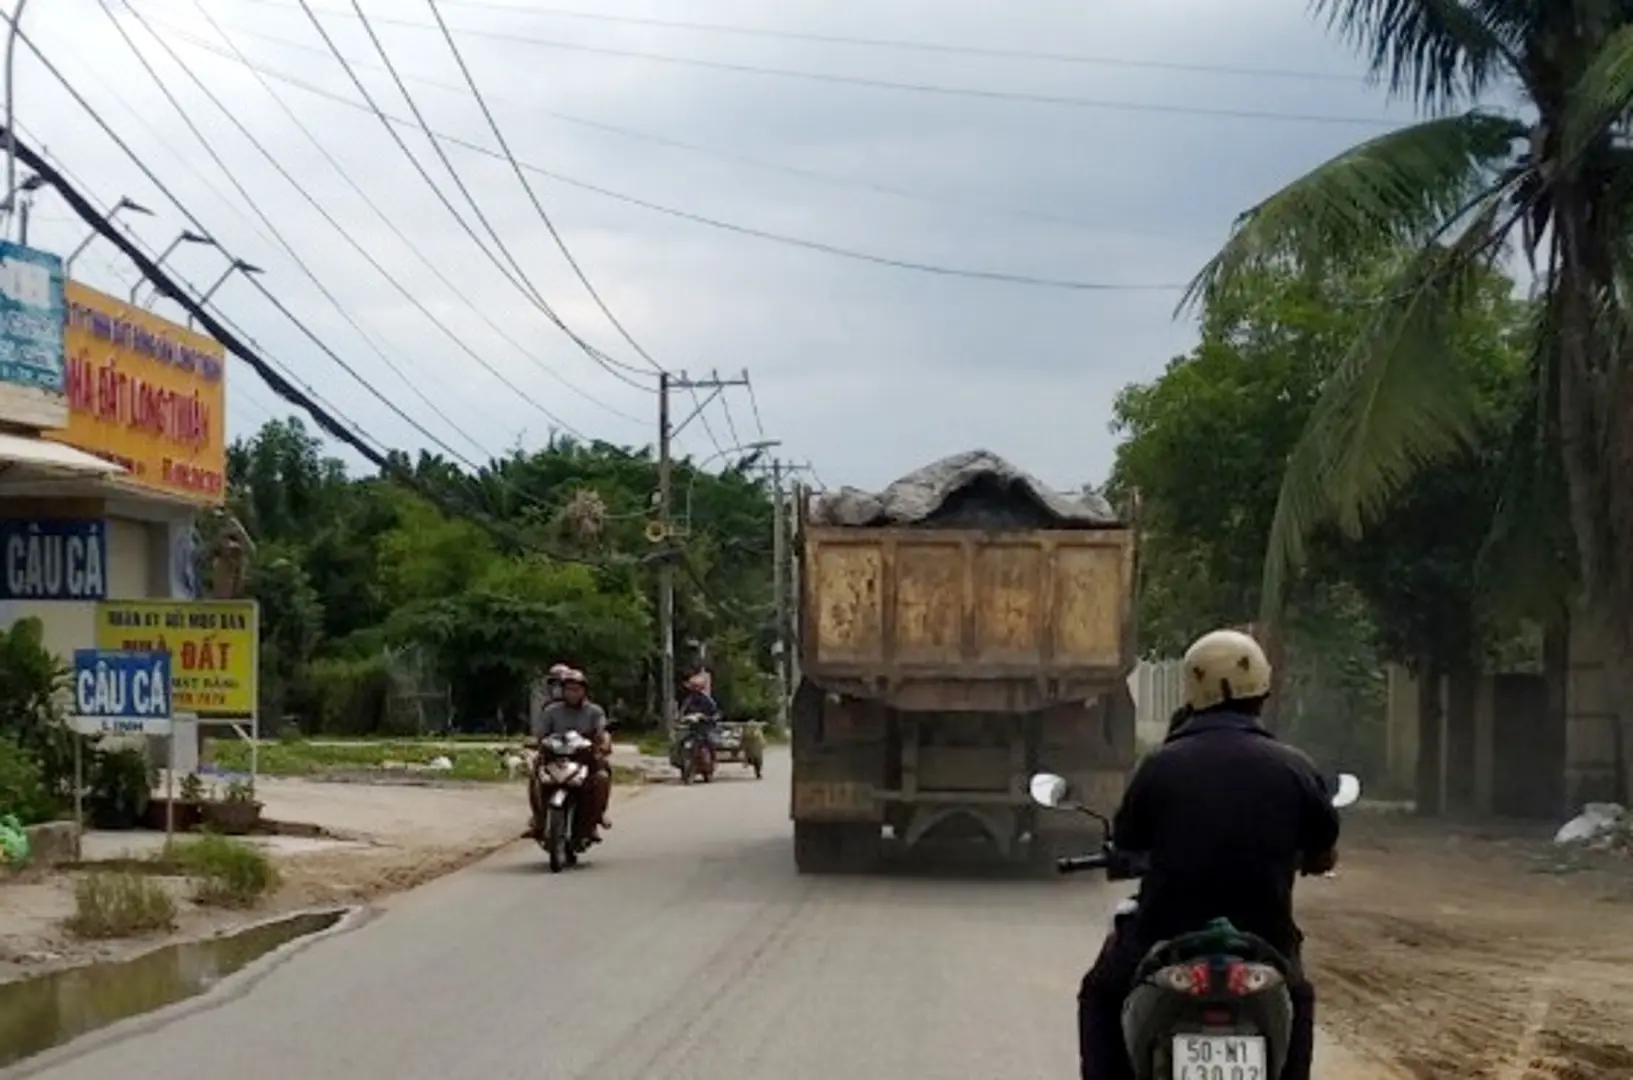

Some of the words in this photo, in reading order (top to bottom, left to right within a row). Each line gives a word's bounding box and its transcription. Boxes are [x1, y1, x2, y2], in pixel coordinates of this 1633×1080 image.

[66, 522, 103, 595] CÁ
[181, 633, 231, 672] ĐẤT
[78, 660, 126, 714] CÂU
[132, 660, 166, 714] CÁ
